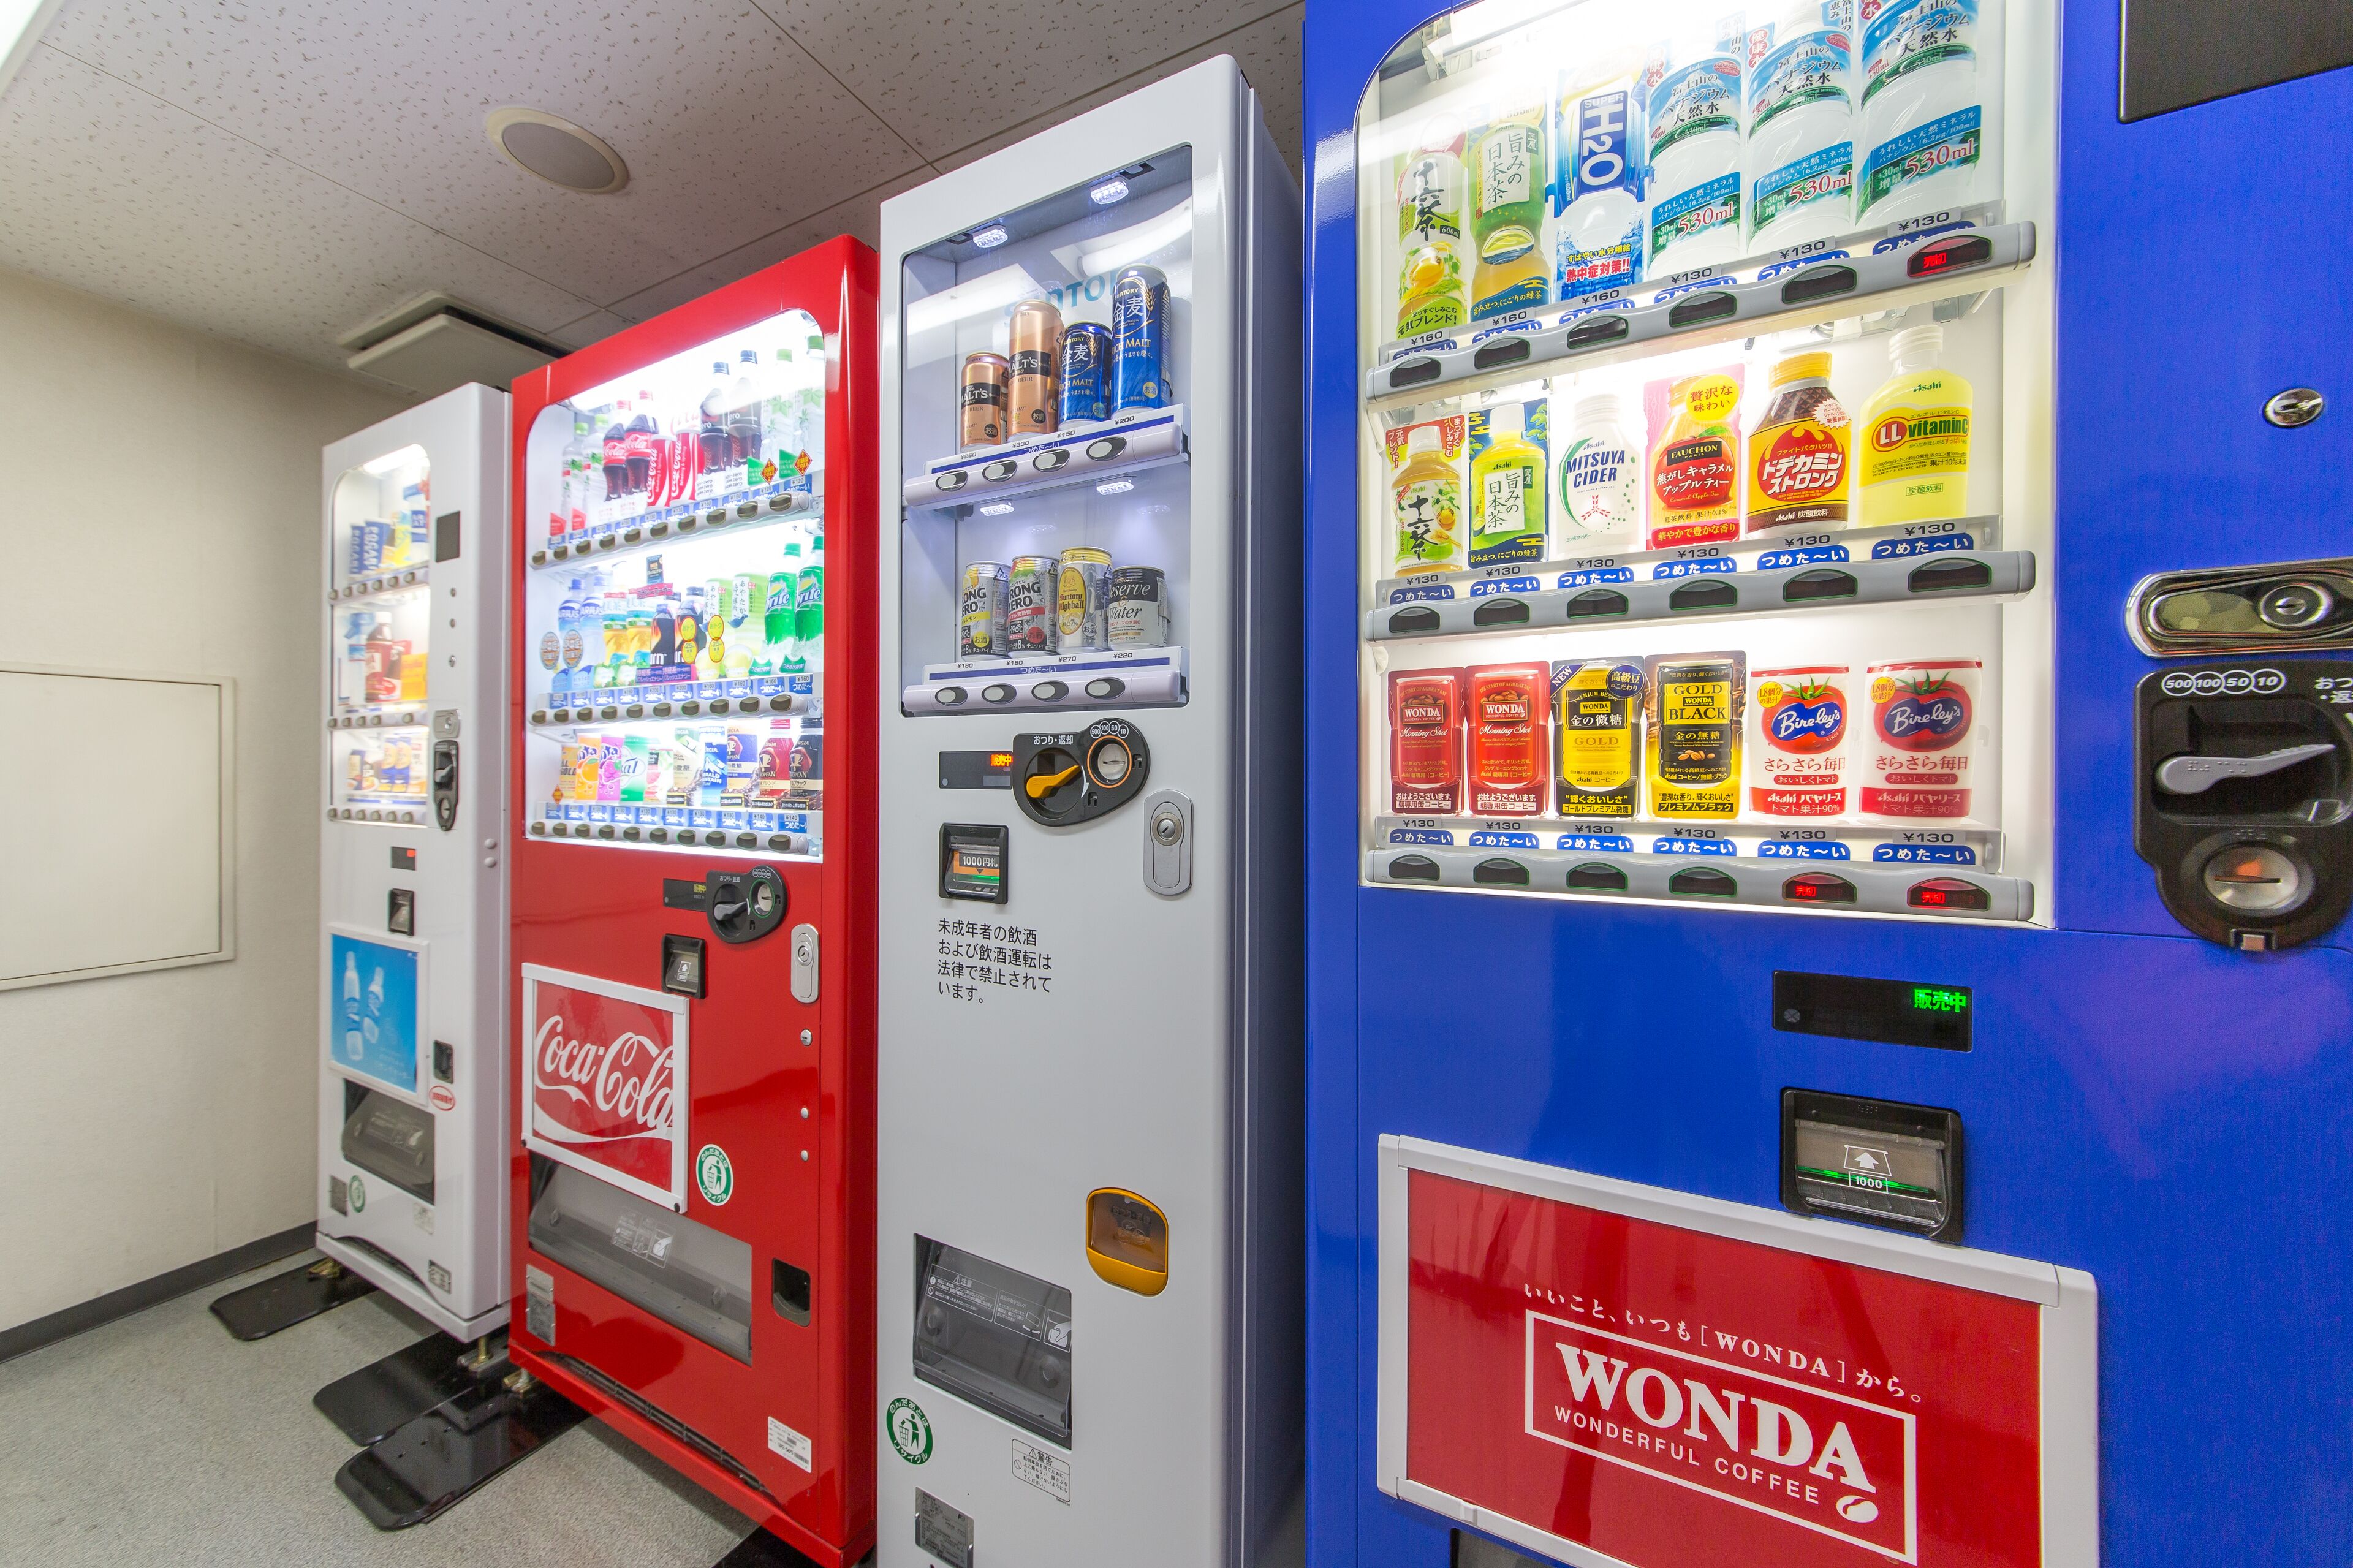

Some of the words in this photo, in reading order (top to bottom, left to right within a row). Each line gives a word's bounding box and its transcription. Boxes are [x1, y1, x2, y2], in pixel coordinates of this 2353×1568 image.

[1898, 28, 1958, 61] 天然水
[1585, 94, 1624, 108] SUPER
[1673, 102, 1719, 127] 天然水
[1581, 104, 1623, 186] H2O
[1507, 133, 1525, 184] 旨みの
[1904, 138, 1974, 179] 530ml
[1486, 142, 1508, 205] 日本茶
[1789, 170, 1852, 205] 530ml
[1677, 203, 1733, 237] 530ml
[1898, 211, 1950, 231] ¥130
[1441, 226, 1460, 238] 600ml
[1567, 244, 1632, 263] すばやい水分補給
[1779, 240, 1826, 259] ¥130
[1671, 267, 1713, 284] ¥130
[1582, 289, 1620, 305] ¥160
[1113, 295, 1144, 325] 金麦
[1492, 311, 1527, 325] ¥160
[1126, 338, 1151, 348] MALT
[1411, 331, 1443, 346] ¥160
[1061, 343, 1089, 366] 金麦
[1072, 378, 1094, 387] MALT
[1913, 381, 1942, 393] Asahi
[1694, 400, 1730, 413] 味わい
[1115, 415, 1135, 425] ¥200
[1879, 423, 1902, 445] LL
[1012, 440, 1029, 449] ¥330
[1671, 444, 1718, 459] FAUCHON
[1493, 461, 1512, 470] Asahi
[1566, 449, 1625, 475] MITSUYA
[1762, 452, 1843, 480] ドデカミン
[1574, 467, 1618, 488] CIDER
[1656, 463, 1734, 487] 焦がしキャラメル
[1767, 471, 1838, 495] ストロング
[1908, 484, 1942, 495] 炭酸飲料
[1504, 472, 1521, 513] 旨みの
[1487, 480, 1507, 528] 日本茶
[1776, 511, 1795, 522] Asahi
[1797, 508, 1828, 518] 炭酸飲料
[1407, 495, 1438, 561] 十六茶
[1658, 524, 1735, 542] 華やかで豊かな香り
[1904, 522, 1955, 536] ¥130
[1784, 534, 1830, 547] ¥130
[1677, 547, 1719, 559] ¥130
[1576, 559, 1615, 569] ¥130
[1486, 566, 1521, 577] ¥130
[1406, 574, 1439, 586] ¥130
[1059, 593, 1083, 602] Suntory
[1058, 599, 1085, 612] Highball
[1083, 625, 1096, 634] お酒
[1552, 665, 1572, 687] NEW
[1610, 672, 1640, 684] 高級豆
[2196, 678, 2221, 687] 100
[2226, 678, 2250, 686] 50
[2257, 676, 2278, 686] 10
[1610, 681, 1639, 692] のこだわり
[1674, 684, 1722, 695] GOLD
[2165, 680, 2192, 689] 500
[1405, 708, 1441, 718] WONDA
[1486, 703, 1525, 714] WONDA
[1669, 707, 1727, 721] BLACK
[1570, 714, 1623, 726] 金の微糖
[1400, 727, 1429, 738] Morning
[1430, 725, 1448, 737] Shot
[1479, 724, 1514, 736] Morning
[1514, 723, 1532, 733] Shot
[1674, 731, 1721, 740] 金の無糖
[1033, 735, 1074, 746] おつり・返却
[1574, 737, 1619, 746] GOLD
[1764, 757, 1846, 772] さらさら毎日
[1876, 755, 1968, 771] さらさら毎日
[1778, 775, 1836, 784] おいしくトマト
[1890, 774, 1955, 782] おいしくトマト
[1477, 793, 1537, 802] おはようございます。
[1768, 793, 1797, 803] Asahi
[1799, 792, 1842, 803] バヤリース
[1877, 792, 1909, 802] Asahi
[1912, 793, 1961, 803] バヤリース
[1398, 800, 1450, 809] 朝専用缶コーヒー
[1480, 801, 1534, 811] 朝専用缶コーヒー
[1660, 803, 1732, 812] プレミアムブラック
[1772, 803, 1840, 814] トマト果汁90%
[1882, 805, 1958, 814] トマト果汁90%
[1403, 819, 1435, 828] ¥130
[1486, 822, 1521, 830] ¥130
[1575, 825, 1613, 834] ¥130
[1673, 828, 1716, 839] ¥130
[1779, 830, 1827, 839] ¥130
[1903, 833, 1955, 843] ¥130
[962, 855, 998, 868] 1000円札
[938, 918, 1037, 947] 未成年者の飲酒
[938, 939, 1052, 971] および飲酒運転は
[938, 959, 1052, 993] 法律で禁止されて
[938, 980, 983, 1004] います。
[1914, 988, 1966, 1012] 販売中
[533, 1015, 675, 1130] Coca-Cola
[1854, 1176, 1883, 1189] 1000
[961, 1277, 973, 1288] 注意
[889, 1398, 929, 1428] のんだあとは
[1555, 1341, 1876, 1494] WONDA
[893, 1439, 928, 1464] リサイクル
[1554, 1404, 1700, 1466] WONDERFUL
[1714, 1457, 1819, 1505] COFFEE
[1037, 1451, 1053, 1467] 警告
